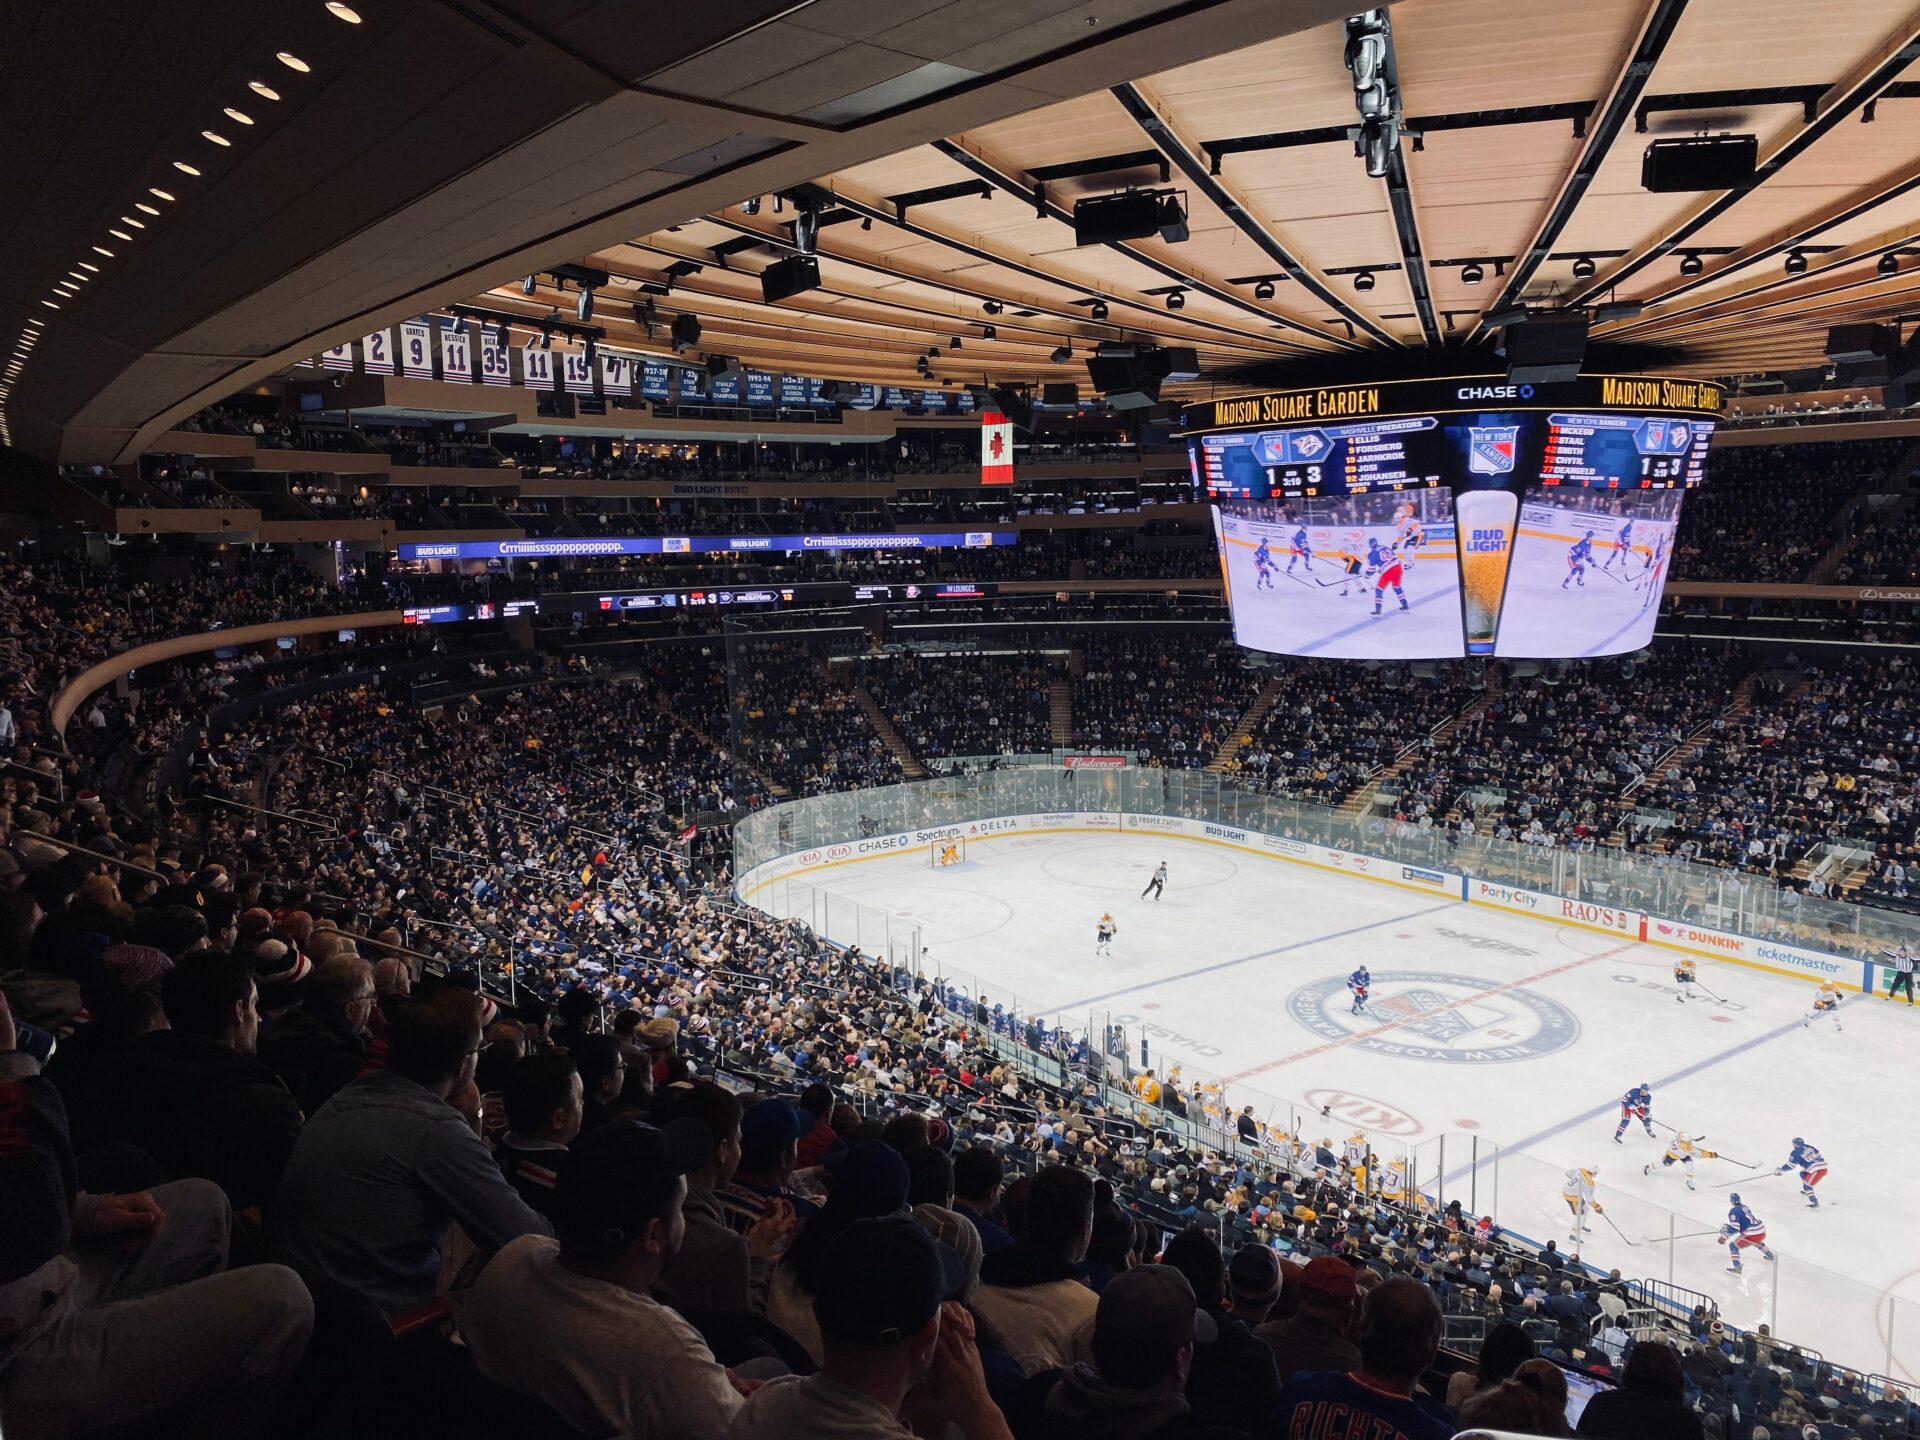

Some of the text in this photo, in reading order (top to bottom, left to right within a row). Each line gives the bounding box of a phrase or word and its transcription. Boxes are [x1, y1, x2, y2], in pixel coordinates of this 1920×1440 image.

[371, 333, 384, 361] 2
[410, 338, 423, 365] 9
[447, 344, 466, 371] 11
[483, 347, 508, 374] 35
[529, 353, 548, 378] 11
[567, 356, 589, 381] 19
[610, 360, 622, 383] 7
[747, 374, 772, 382] 1993-94
[712, 392, 739, 400] CHAMPIONS
[1457, 386, 1518, 400] CHASE
[1602, 378, 1660, 405] MADISON
[1662, 380, 1697, 409] SQUARE
[1215, 389, 1379, 425] MADISON SQUARE GARDEN
[1341, 421, 1423, 435] NASHVILLE PREDATORS
[1599, 419, 1627, 427] RANGERS
[1475, 431, 1513, 441] NEW YORK
[1560, 427, 1595, 436] MCKEGG
[1347, 435, 1380, 445] 4 ELLIS
[1558, 436, 1585, 445] STAAL
[1356, 442, 1403, 454] FORSBERG
[1557, 446, 1584, 455] SMITH
[1345, 452, 1406, 464] 19 JARNKROK
[1479, 443, 1511, 470] RANGERS
[1544, 455, 1584, 465] 72 CHYTIL
[1357, 464, 1378, 473] JOSI
[1542, 465, 1596, 475] 77 DEANGELO
[1641, 458, 1651, 475] 1
[1670, 458, 1682, 476] 3
[1266, 468, 1275, 485] 1
[1306, 466, 1321, 483] 3
[1358, 471, 1407, 482] JOHANSEN
[1283, 478, 1302, 486] 3:10
[673, 485, 694, 494] BUD
[695, 485, 722, 494] LIGHT
[1271, 489, 1281, 497] 27
[1306, 488, 1317, 496] 13
[1472, 529, 1504, 540] BUD
[417, 546, 457, 555] BUD LIGHT
[748, 540, 769, 548] LIGHT
[1466, 540, 1508, 551] LIGHT
[680, 594, 687, 605] 1
[708, 593, 717, 604] 3
[1070, 757, 1122, 768] Budweiser
[1043, 813, 1075, 821] Northwell
[980, 819, 1017, 831] DELTA
[916, 828, 958, 843] Spectrum
[1205, 826, 1246, 842] BUD LIGHT
[831, 847, 848, 857] KIA
[858, 837, 897, 853] CHASE
[803, 852, 818, 863] KIA
[1480, 883, 1538, 908] Party City
[1561, 899, 1614, 927] RAO'S
[1688, 930, 1743, 951] DUNKIN'
[1757, 946, 1841, 973] ticketmaster
[1296, 988, 1346, 1038] RANGERS
[1136, 1022, 1223, 1057] CHASE
[1359, 1038, 1532, 1060] NEW YORK
[1318, 1092, 1409, 1129] KIA
[1349, 1146, 1359, 1160] 13
[1289, 1401, 1409, 1440] RICHT
